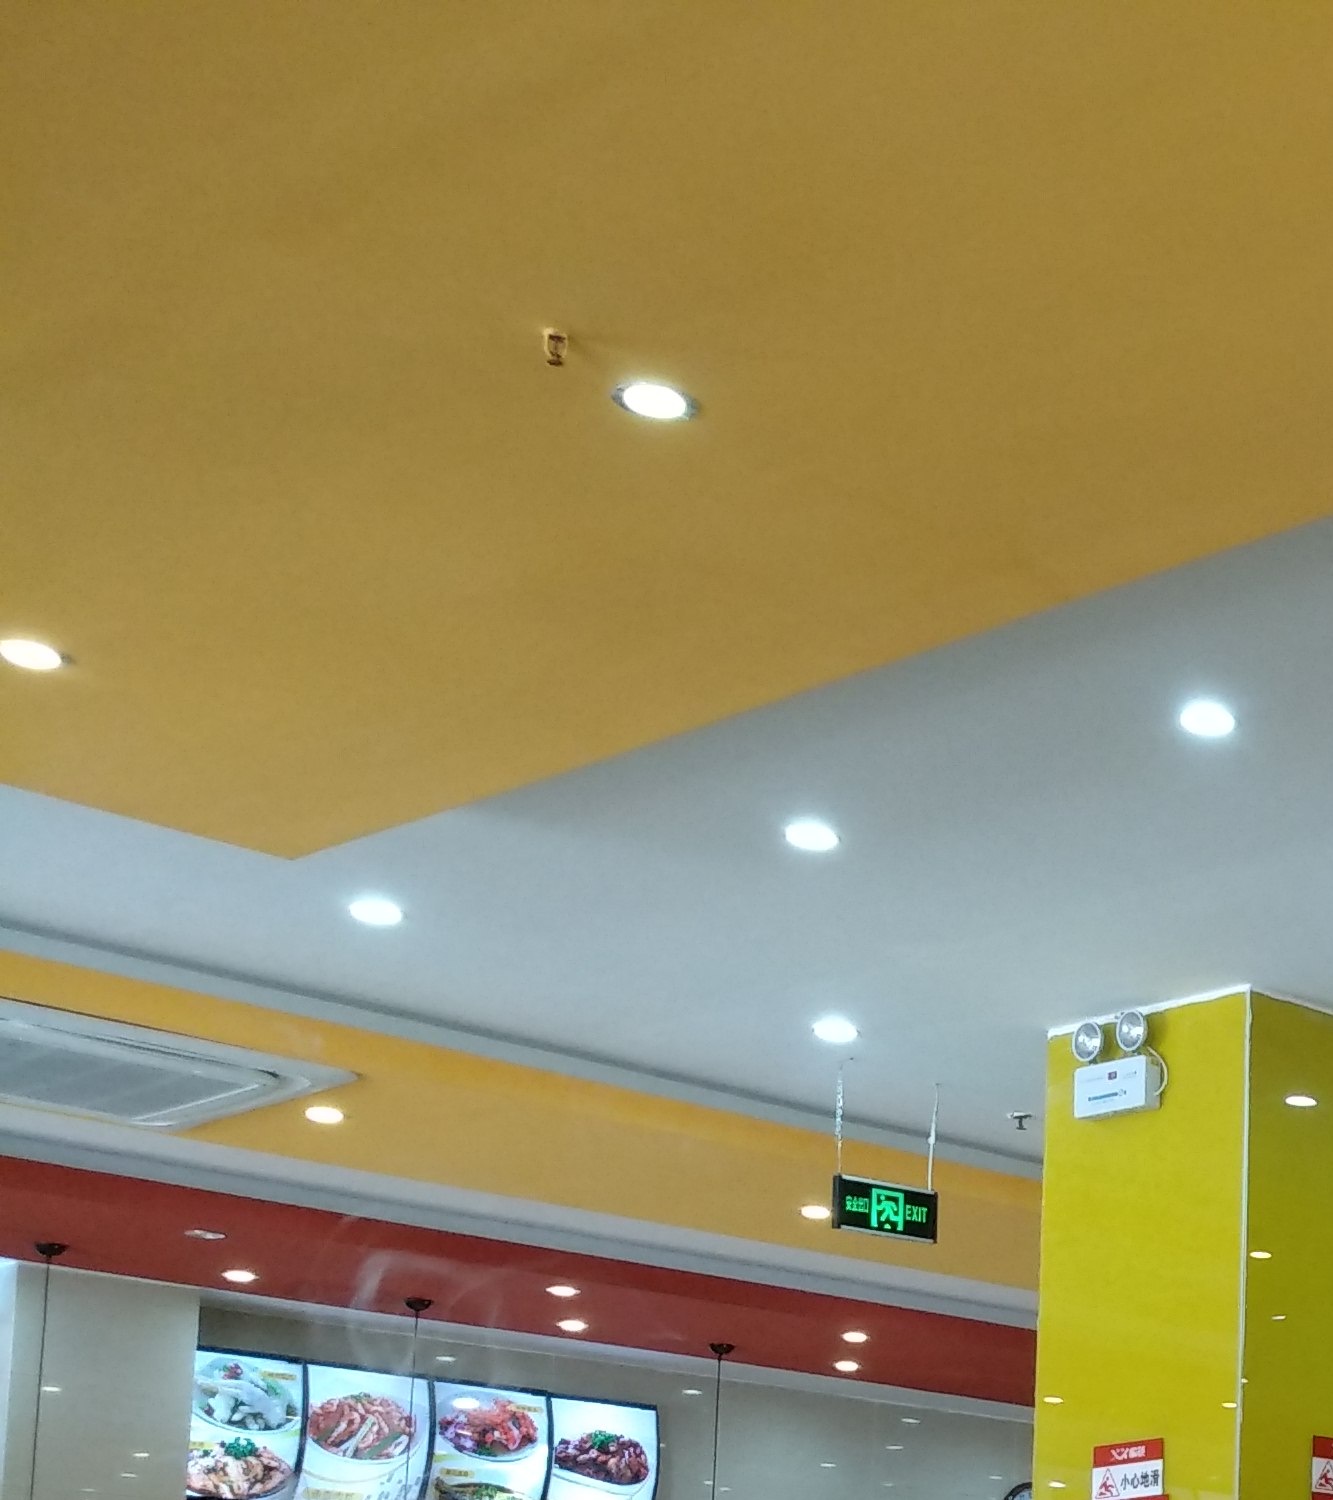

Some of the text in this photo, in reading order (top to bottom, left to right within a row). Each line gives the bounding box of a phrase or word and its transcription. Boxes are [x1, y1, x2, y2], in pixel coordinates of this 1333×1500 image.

[906, 1205, 928, 1223] EXIT
[1121, 1469, 1160, 1491] 小心地滑
